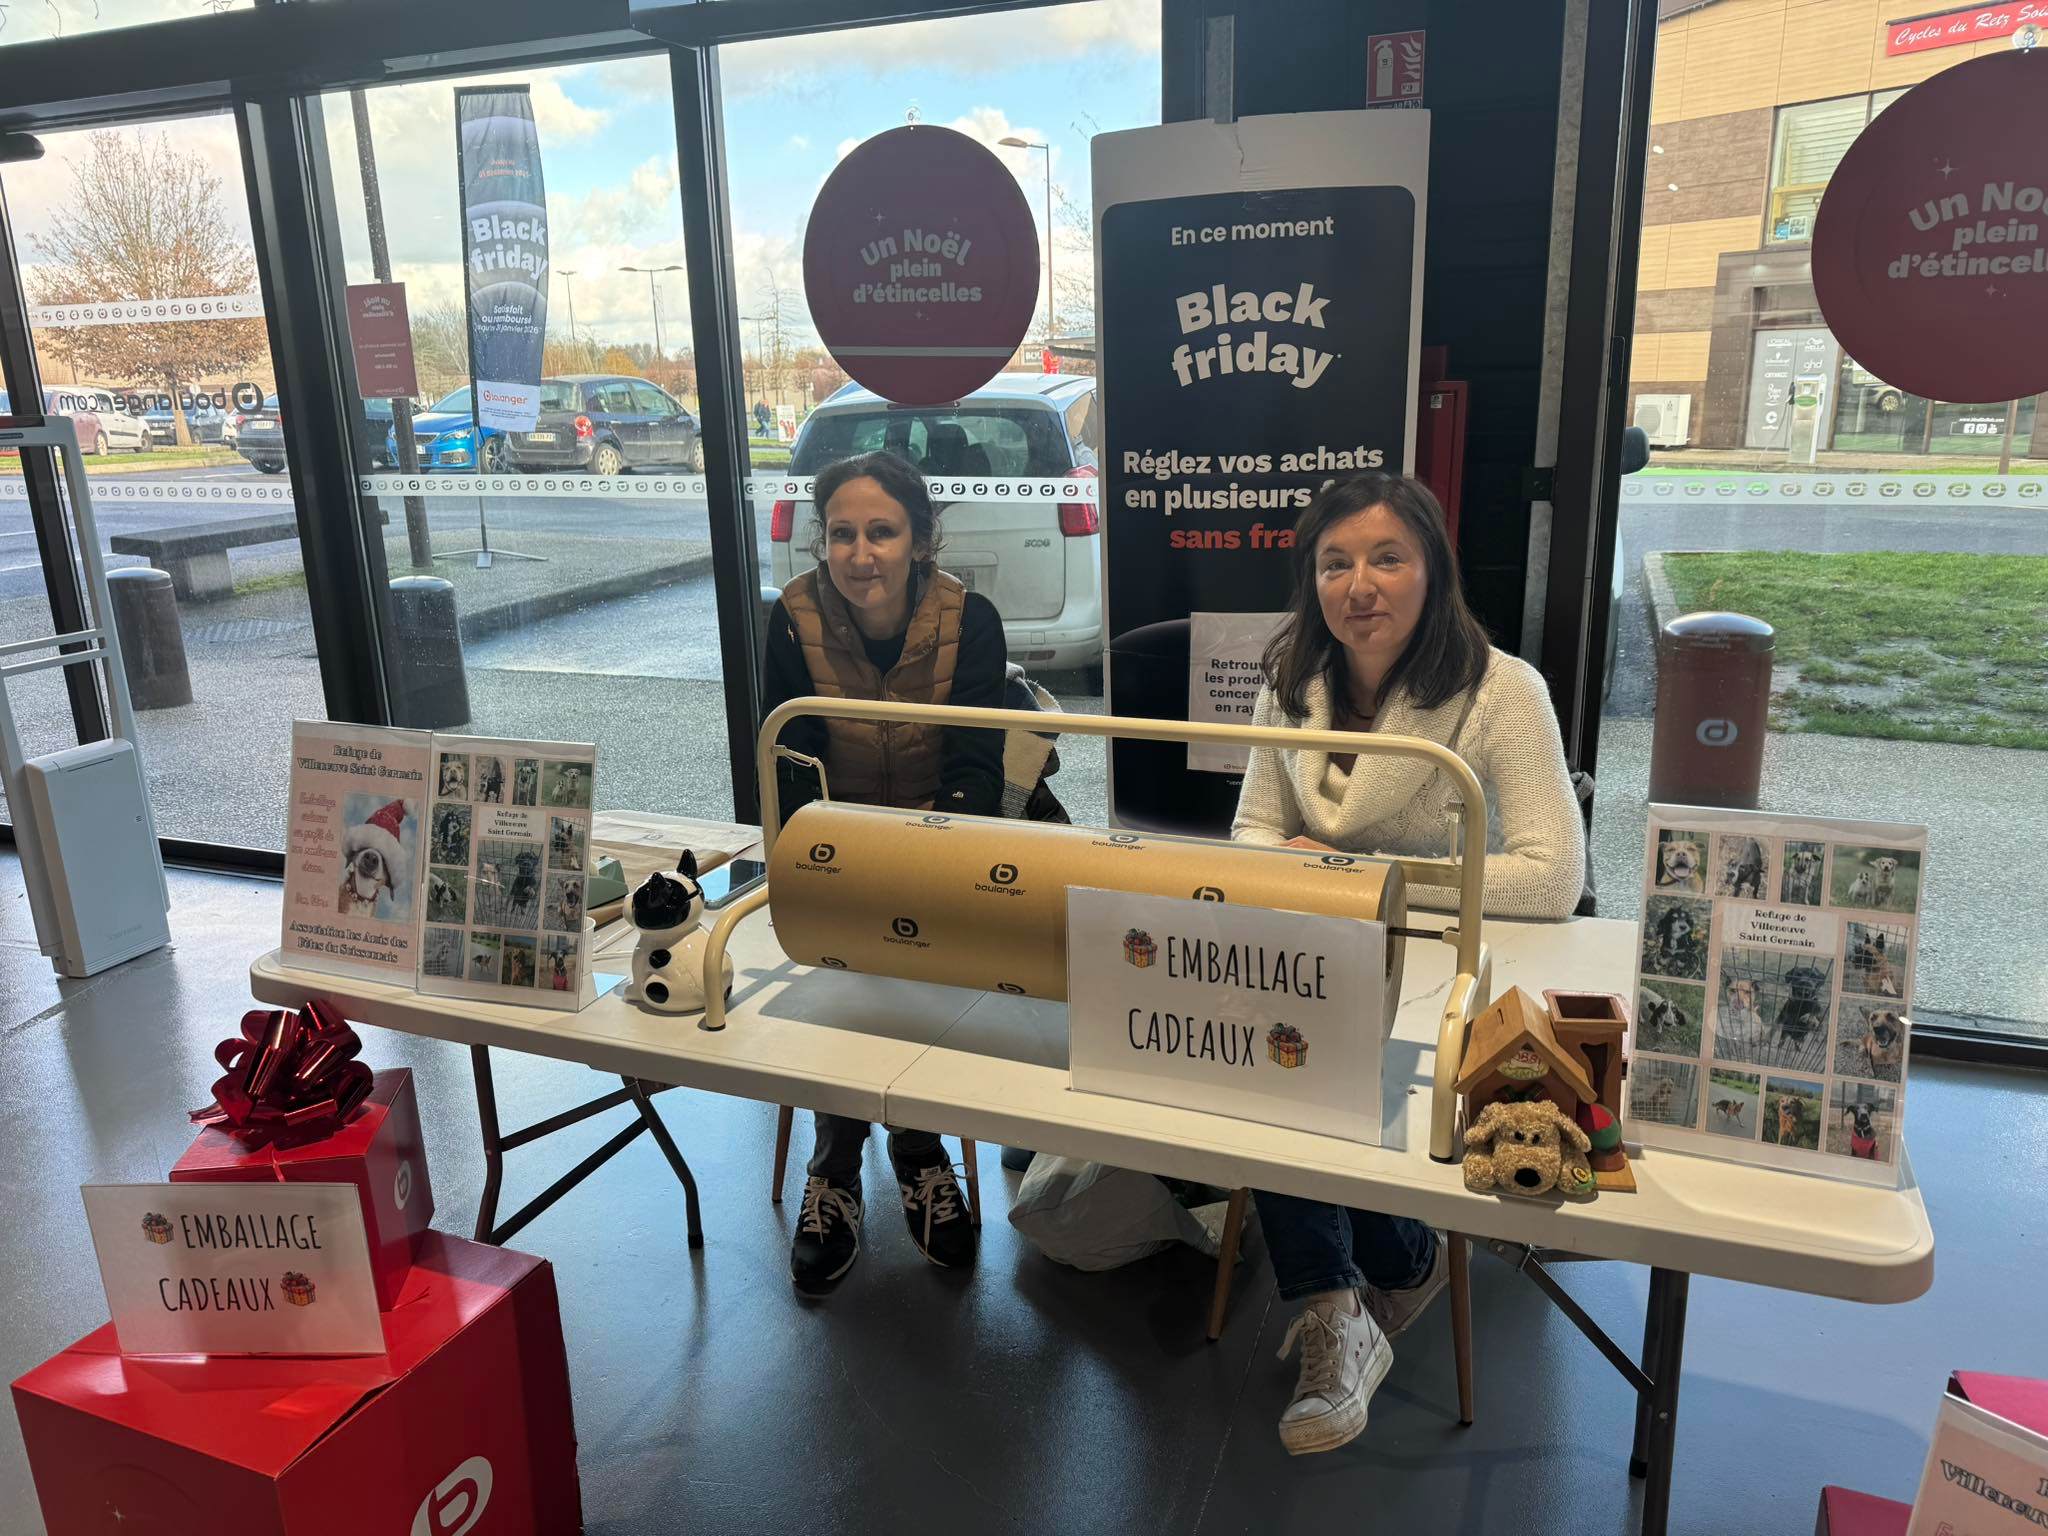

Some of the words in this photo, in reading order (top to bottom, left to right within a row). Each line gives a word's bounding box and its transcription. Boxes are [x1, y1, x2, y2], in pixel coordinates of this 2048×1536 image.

[1895, 25, 1942, 46] Cycles
[1948, 20, 1968, 33] du
[1976, 12, 2011, 29] Retz
[1908, 193, 1970, 232] Un
[1982, 181, 2048, 218] No
[471, 213, 546, 247] Black
[1171, 226, 1196, 246] En
[1200, 225, 1227, 243] ce
[1231, 216, 1335, 241] moment
[1952, 218, 2039, 252] plein
[860, 236, 898, 266] Un
[903, 228, 972, 267] Noël
[471, 243, 548, 281] friday
[890, 257, 942, 283] plein
[1887, 247, 2048, 279] d'étincel
[852, 282, 983, 304] d'étincelles
[1175, 282, 1331, 335] Black
[1171, 331, 1334, 389] friday
[1804, 360, 1823, 372] ghd
[1123, 449, 1212, 481] Réglez
[1218, 453, 1273, 474] vos
[1279, 445, 1384, 473] achats
[1125, 488, 1157, 508] en
[1164, 482, 1312, 515] plusieurs
[1170, 529, 1241, 549] sans
[1205, 672, 1225, 683] les
[1210, 688, 1260, 700] concer
[1215, 703, 1232, 713] en
[333, 744, 368, 760] Refuge
[369, 748, 382, 760] de
[297, 757, 349, 774] Villeneuve
[350, 762, 377, 777] Saint
[378, 765, 423, 781] Germain
[905, 821, 954, 831] boulanger
[1091, 840, 1146, 851] boulanger
[795, 861, 842, 875] boulanger
[1303, 861, 1366, 874] boulanger
[974, 882, 1027, 897] boulanger
[1750, 921, 1806, 935] Villeneuve
[1755, 909, 1792, 922] Refuge
[1793, 913, 1807, 922] de
[883, 935, 933, 949] boulanger
[1739, 932, 1768, 943] Saint
[1769, 935, 1816, 948] Germain
[1167, 935, 1327, 1000] EMBALLAGE
[1128, 1008, 1255, 1067] CADEAUX
[180, 1213, 322, 1249] EMBALLAGE
[159, 1277, 275, 1312] CADEAUX
